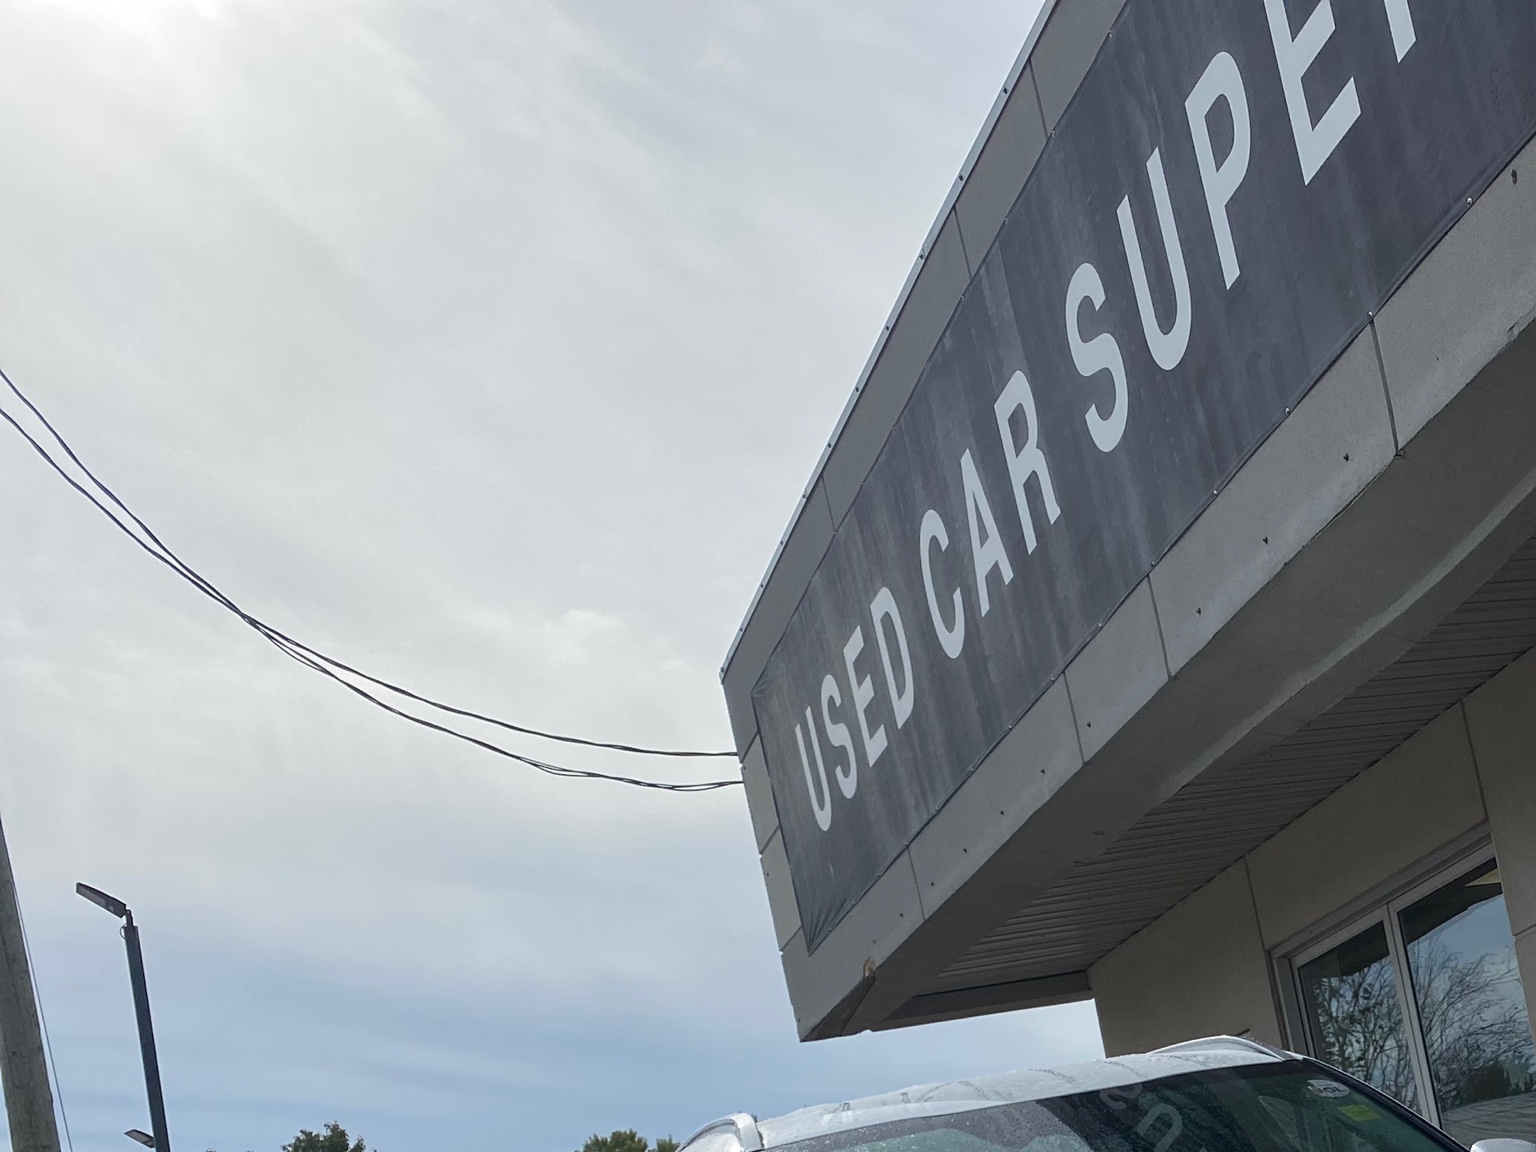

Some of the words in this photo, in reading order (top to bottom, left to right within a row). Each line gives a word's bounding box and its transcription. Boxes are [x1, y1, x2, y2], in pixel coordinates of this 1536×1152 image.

[794, 586, 915, 832] USED
[919, 369, 1062, 659] CAR
[1065, 0, 1417, 453] SUPE
